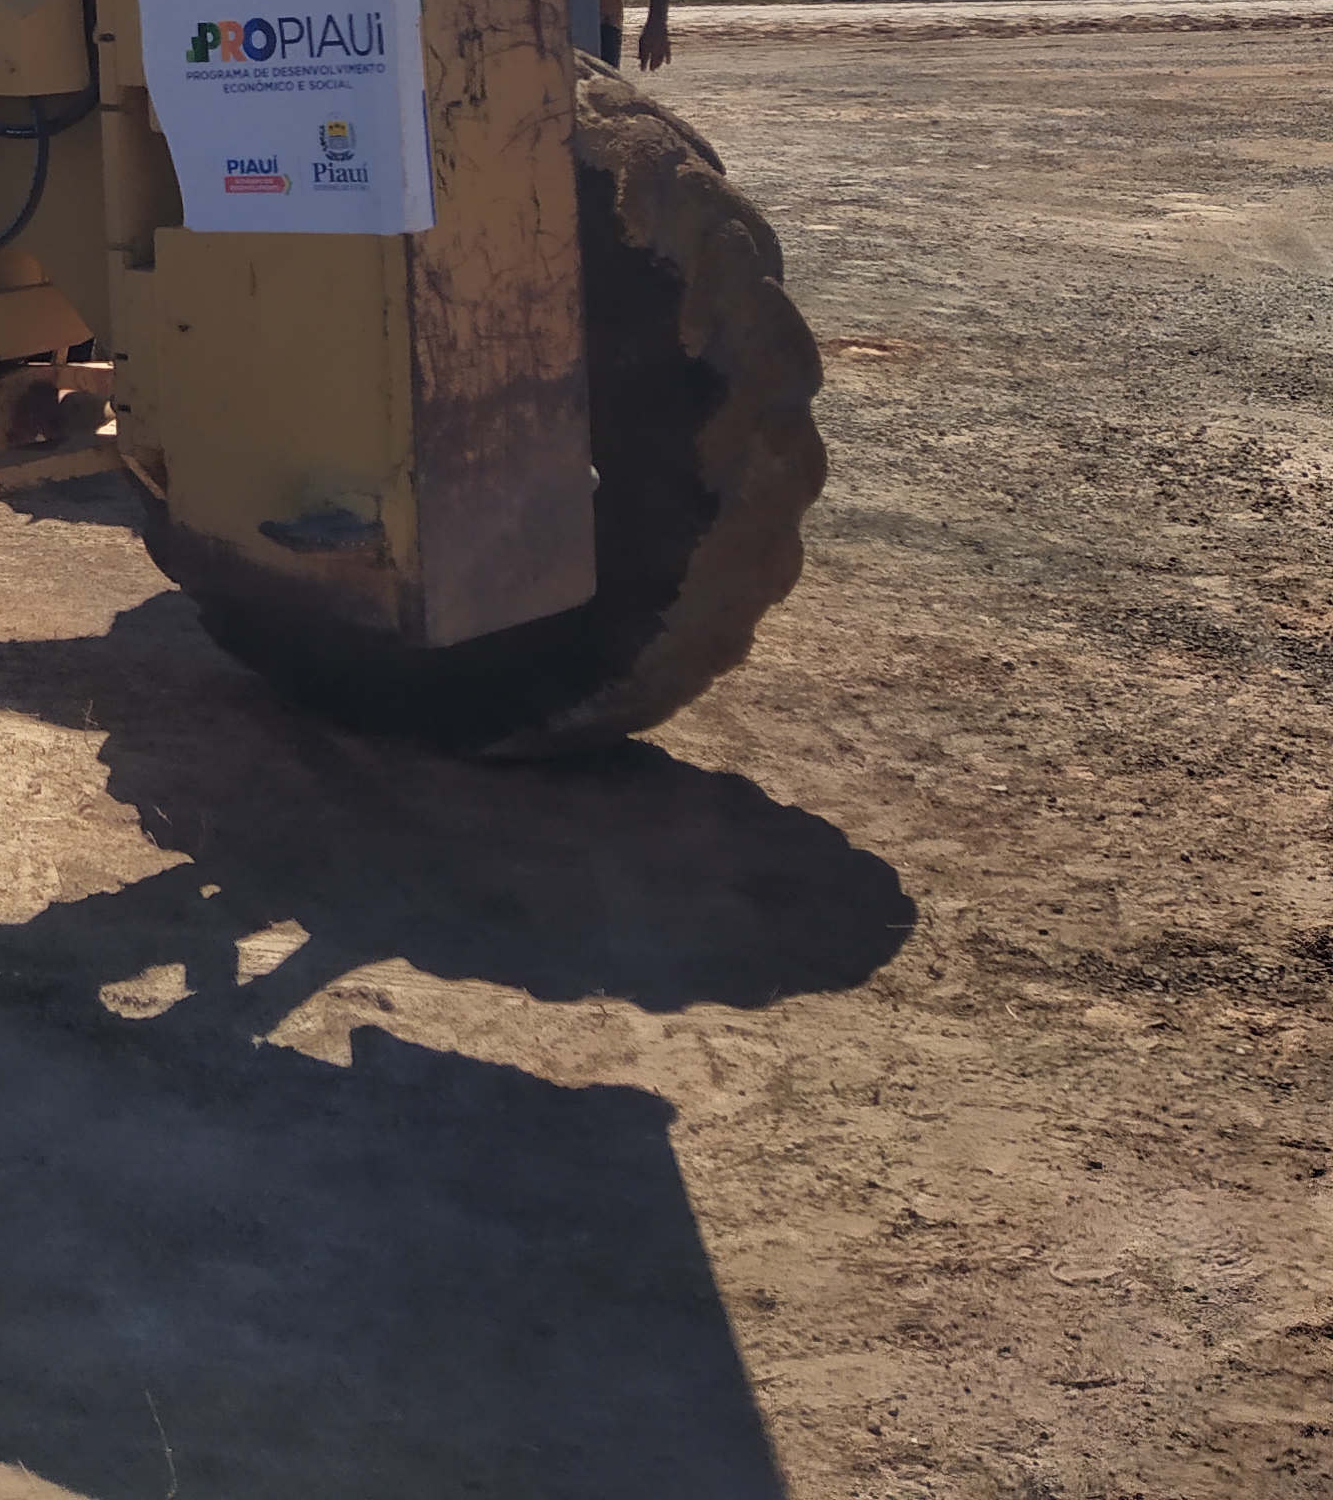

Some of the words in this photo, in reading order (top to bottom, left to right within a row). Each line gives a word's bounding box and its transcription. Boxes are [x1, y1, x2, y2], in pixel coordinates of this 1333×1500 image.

[186, 67, 250, 81] PROGRAMA
[253, 66, 269, 78] DE
[272, 63, 386, 78] DESENVOLVIMENTO
[222, 79, 295, 94] ECONÔMICO
[297, 79, 305, 91] E
[309, 78, 354, 92] SOCIAL
[226, 154, 279, 175] PIAUÍ
[312, 161, 370, 184] Piauí
